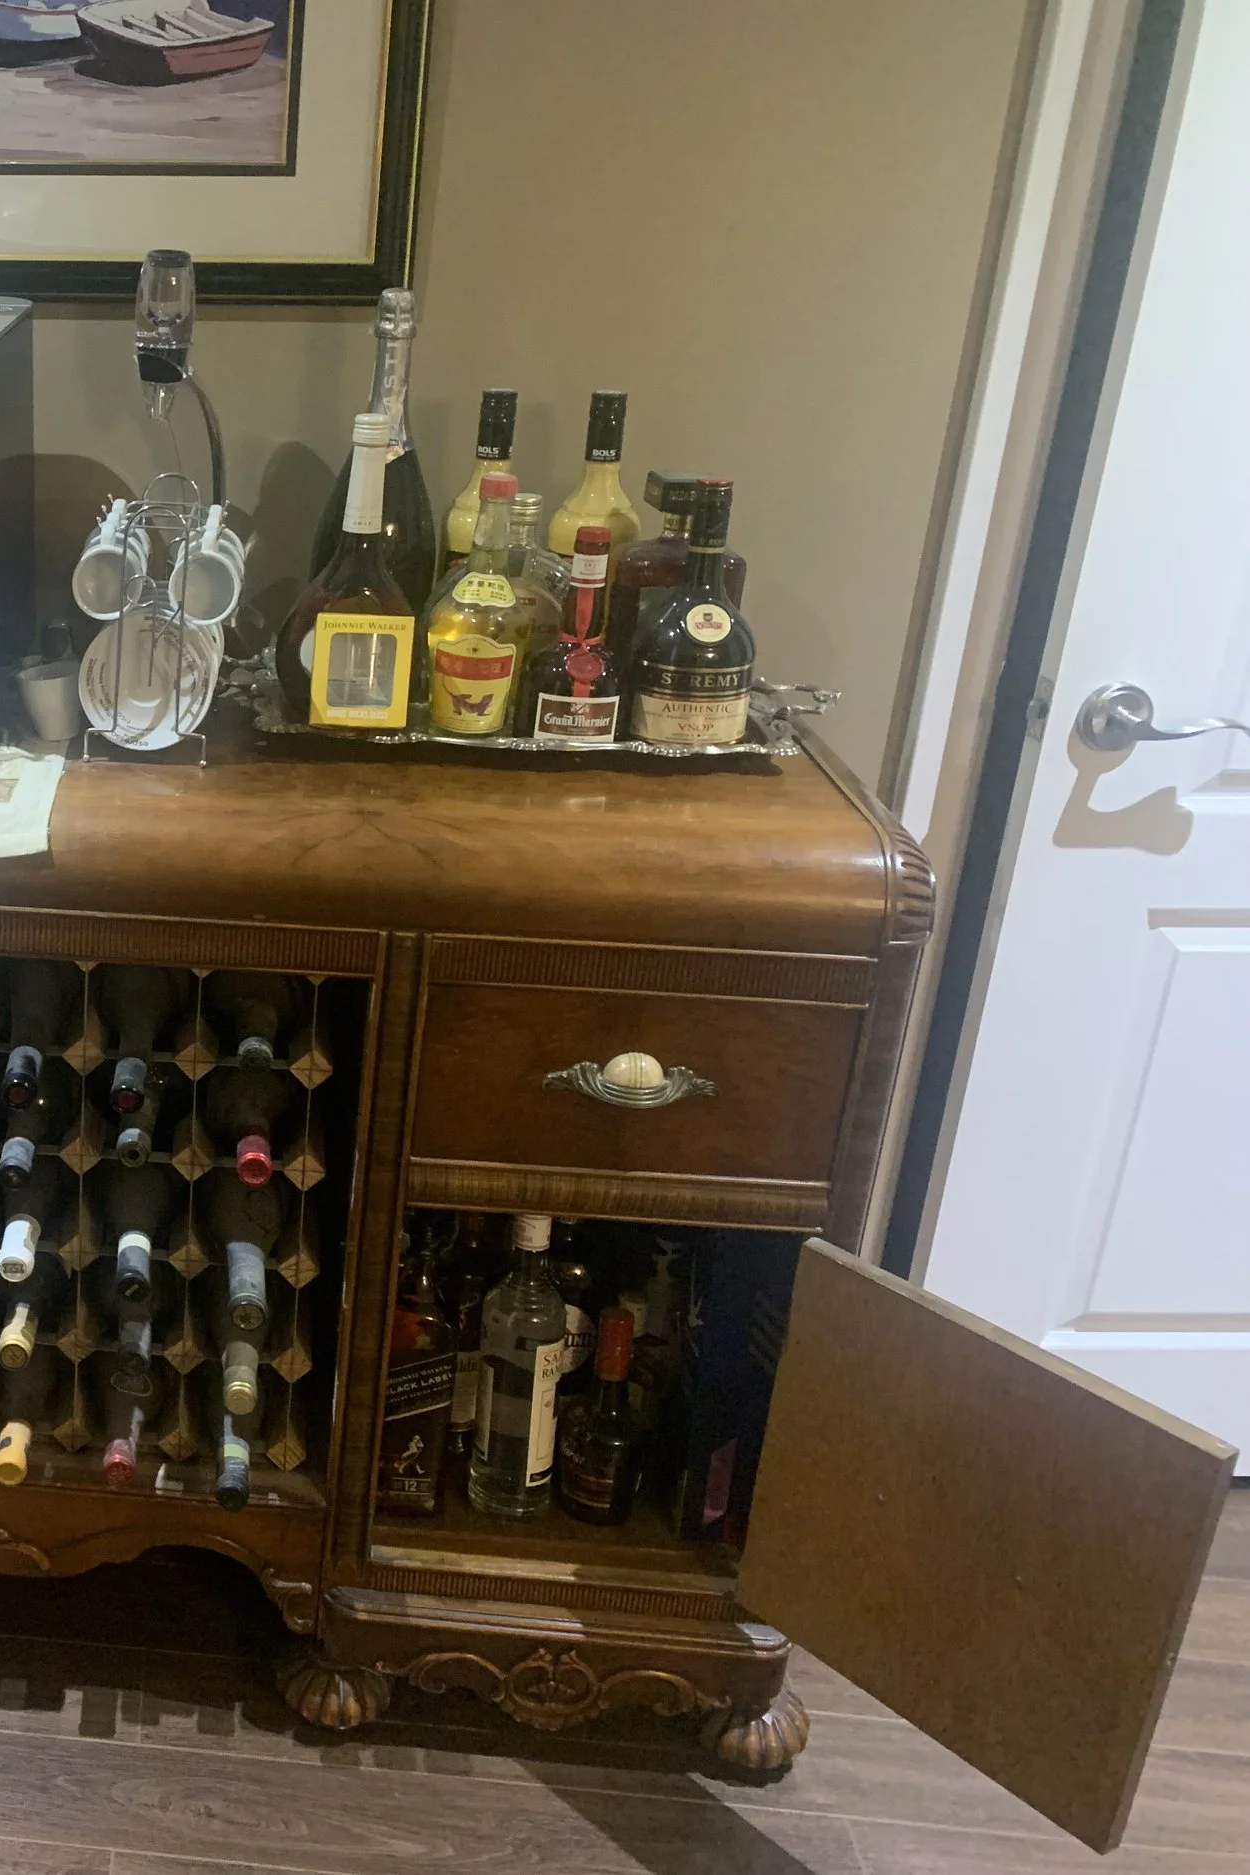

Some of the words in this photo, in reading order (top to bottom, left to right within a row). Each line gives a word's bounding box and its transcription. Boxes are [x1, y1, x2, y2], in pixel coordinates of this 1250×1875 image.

[477, 445, 500, 454] BOLS
[592, 448, 617, 457] BOLS
[323, 620, 365, 631] JOHNNIE
[368, 621, 407, 632] WALKER
[661, 703, 734, 714] AUTHENTIC
[543, 712, 573, 726] Grand
[573, 714, 611, 727] Marnier
[678, 722, 715, 733] VSOP
[388, 1381, 419, 1396] LACK
[420, 1372, 454, 1388] LABEL
[404, 1480, 418, 1492] 12
